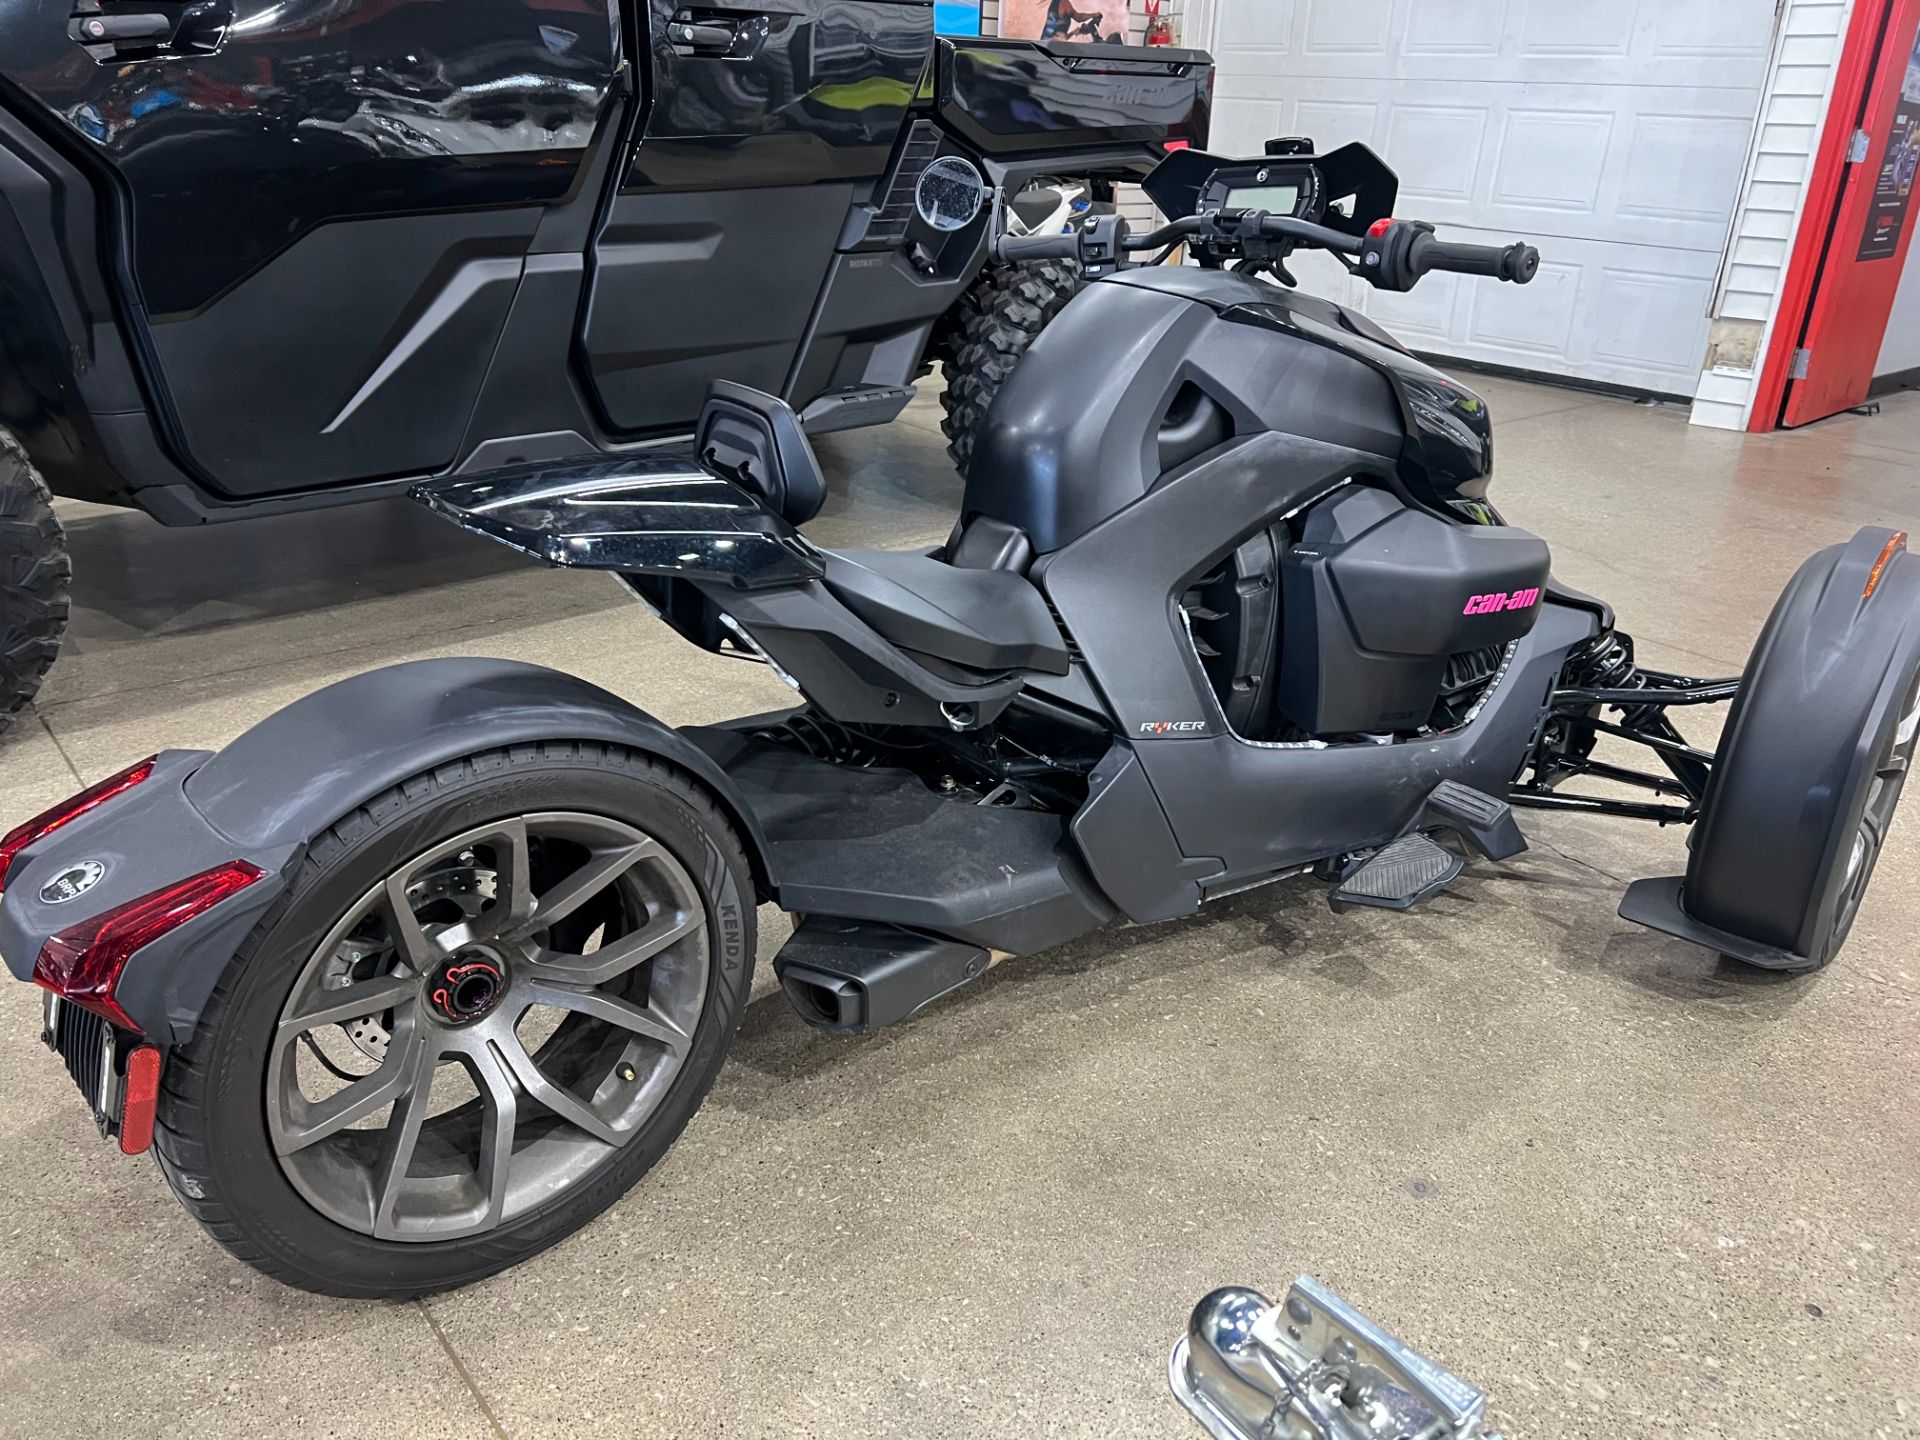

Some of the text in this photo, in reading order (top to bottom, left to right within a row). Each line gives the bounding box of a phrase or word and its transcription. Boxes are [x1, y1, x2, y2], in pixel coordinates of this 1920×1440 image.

[1463, 587, 1539, 615] can-am
[1140, 721, 1206, 734] RYKER
[57, 878, 77, 895] BRP
[720, 904, 740, 971] KENDA
